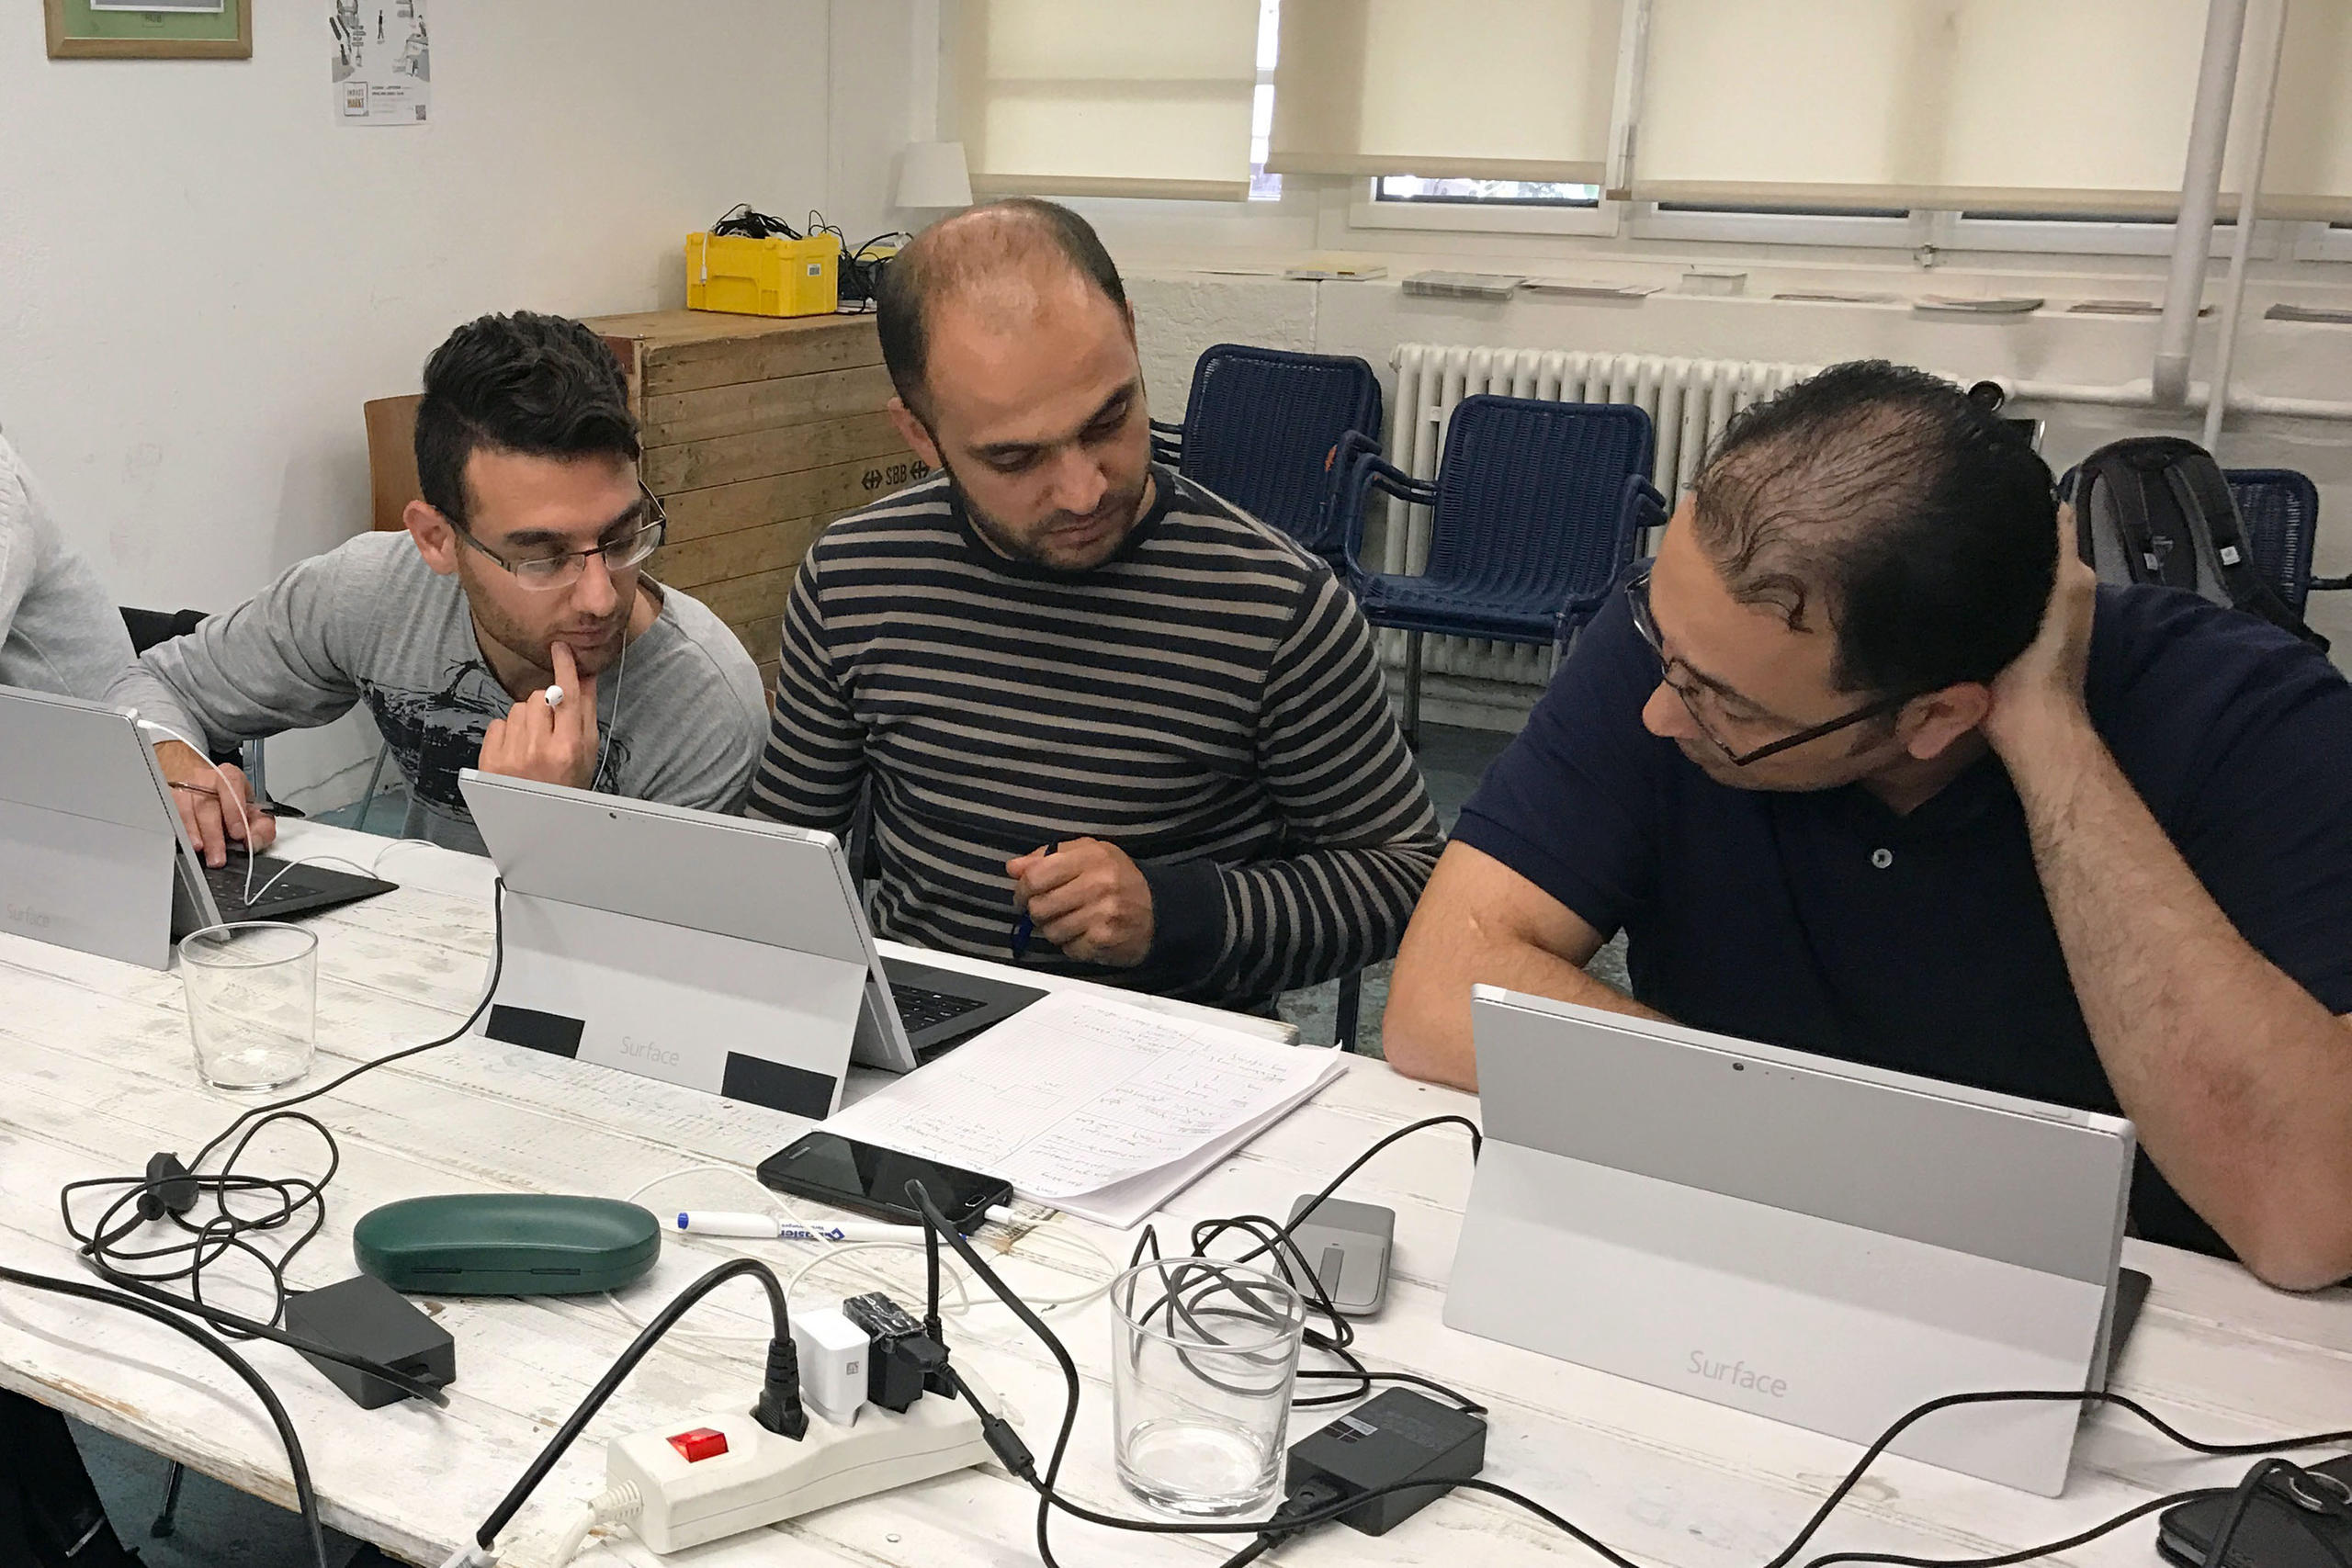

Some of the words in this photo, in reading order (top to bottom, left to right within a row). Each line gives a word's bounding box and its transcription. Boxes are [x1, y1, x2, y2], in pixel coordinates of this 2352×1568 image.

[886, 464, 908, 485] SBB
[619, 1035, 680, 1066] Surface
[1687, 1349, 1787, 1398] Surface
